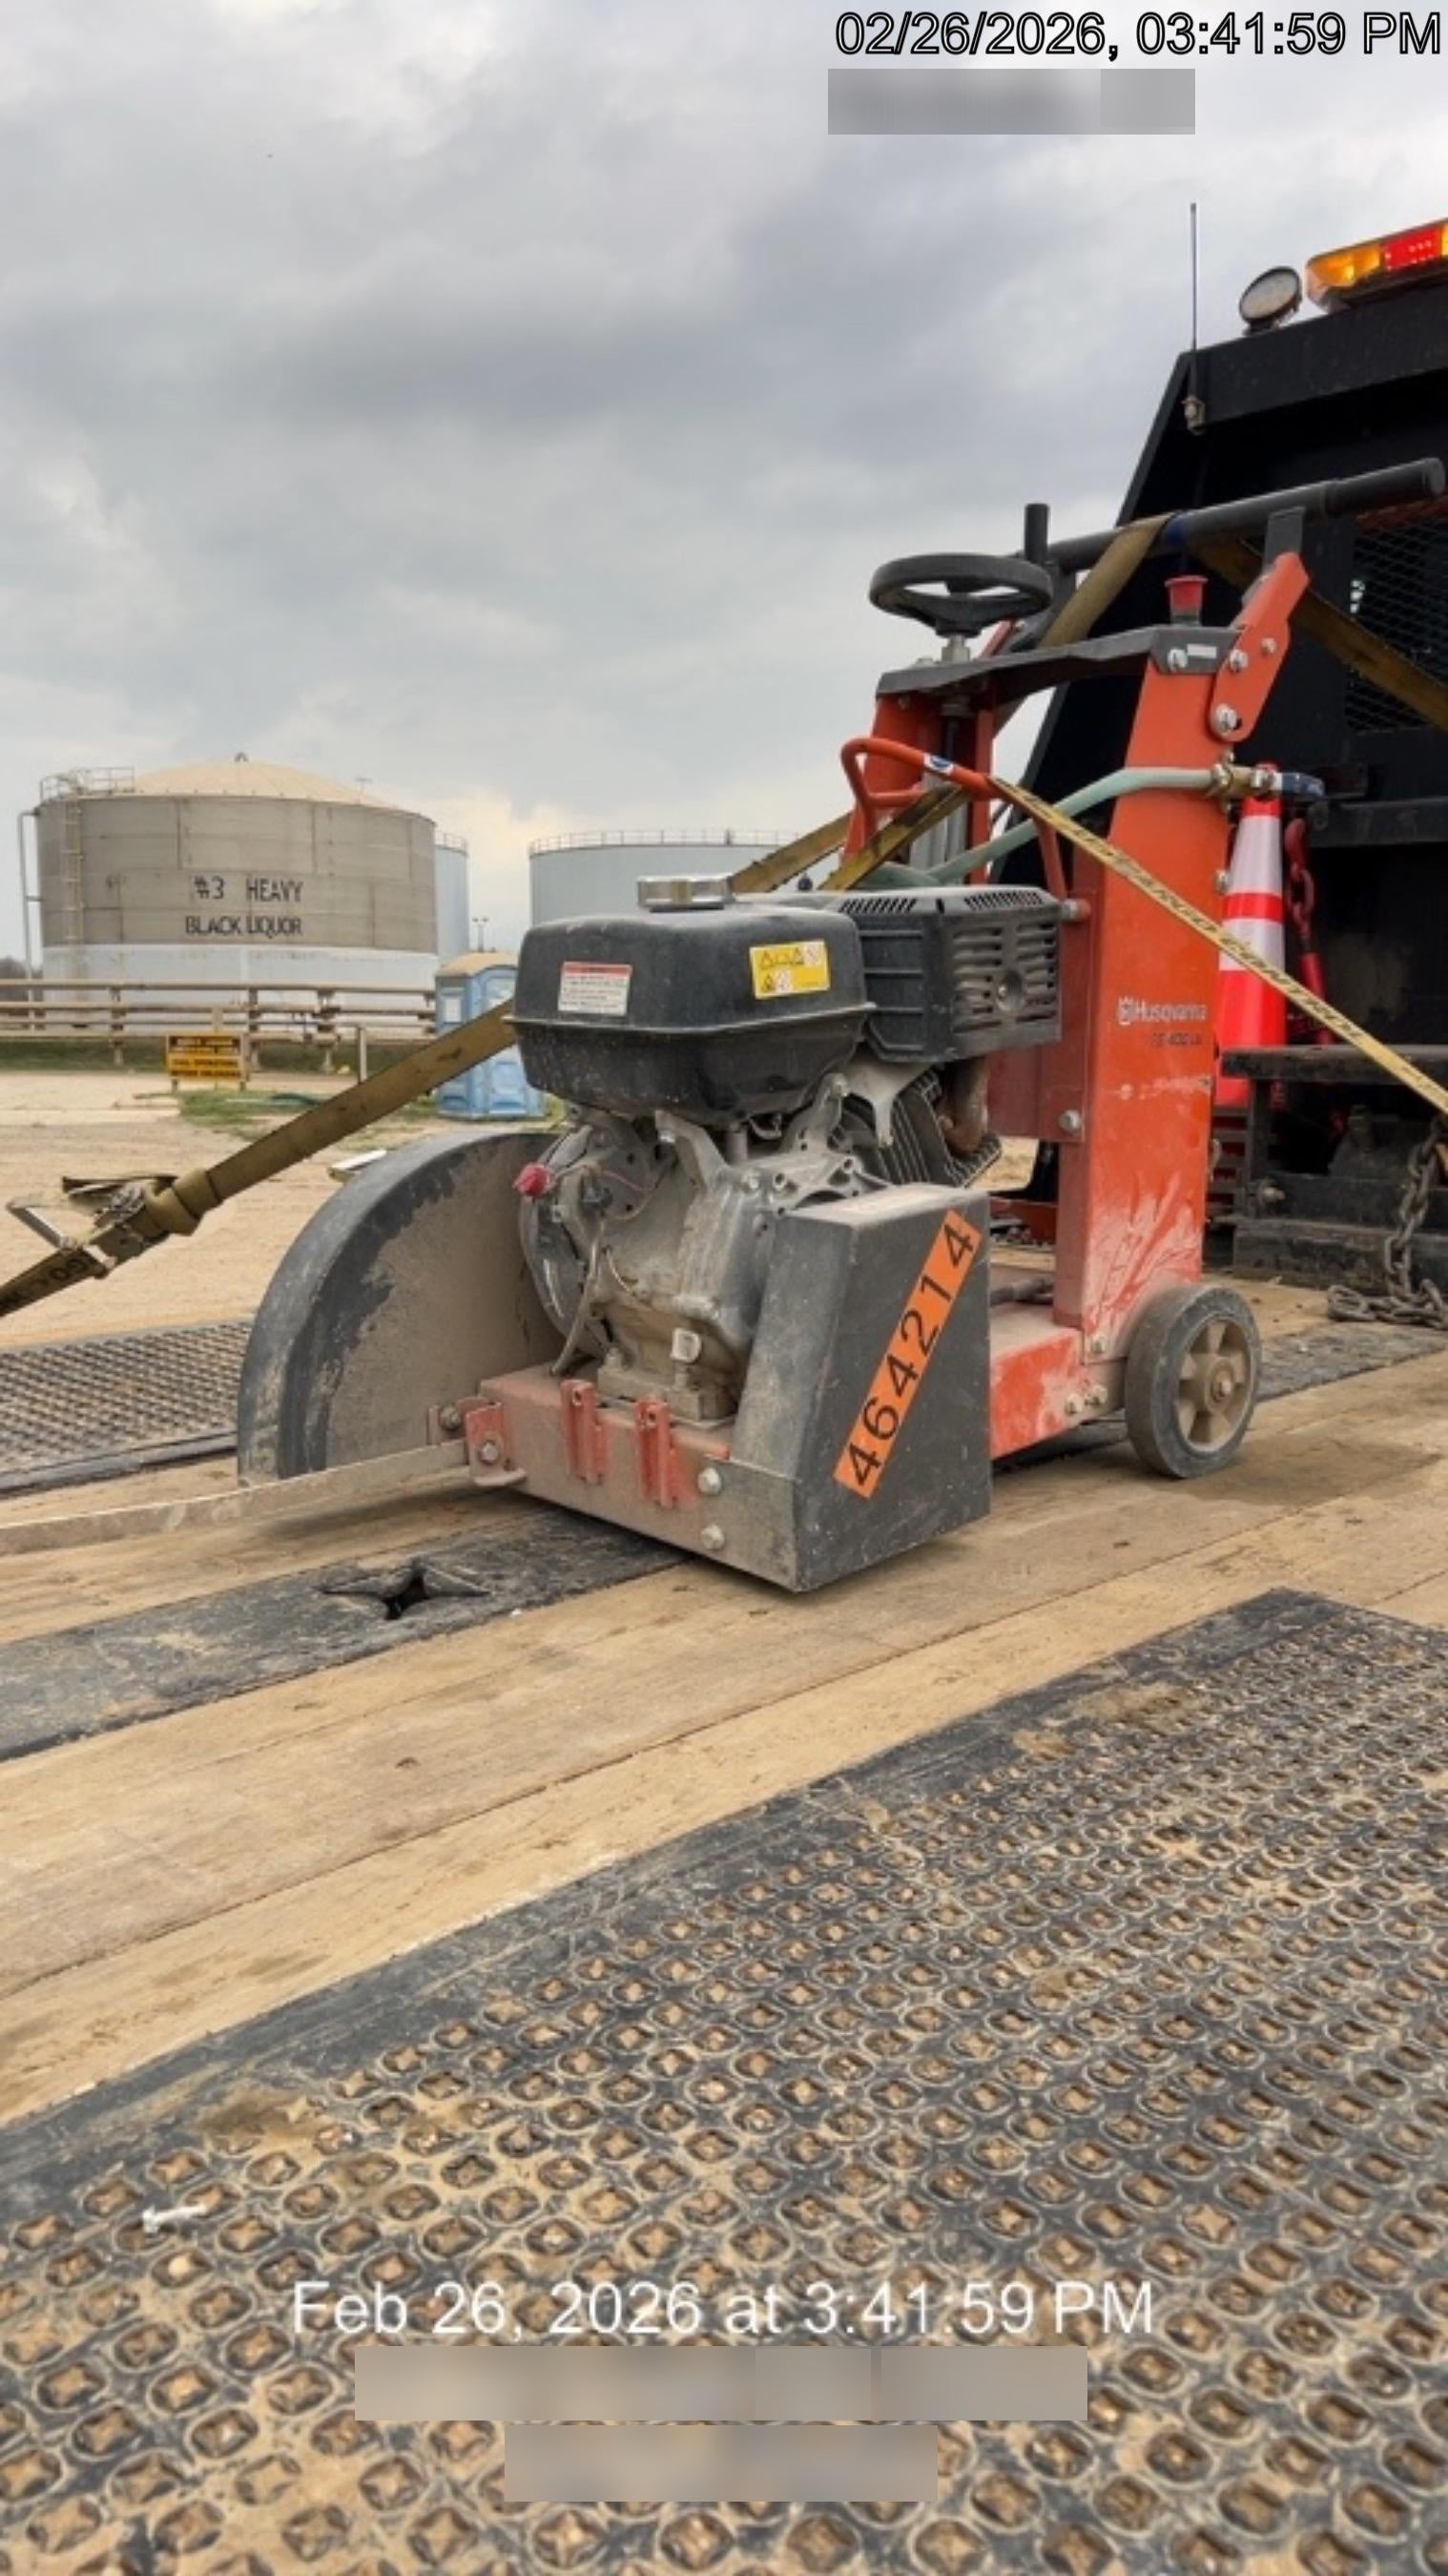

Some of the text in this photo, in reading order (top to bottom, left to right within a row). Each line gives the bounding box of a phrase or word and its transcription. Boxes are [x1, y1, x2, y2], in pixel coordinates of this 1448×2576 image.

[194, 876, 303, 902] #3 HEAVY
[185, 915, 304, 940] BLACK LIQUOR
[848, 1222, 975, 1487] 464214
